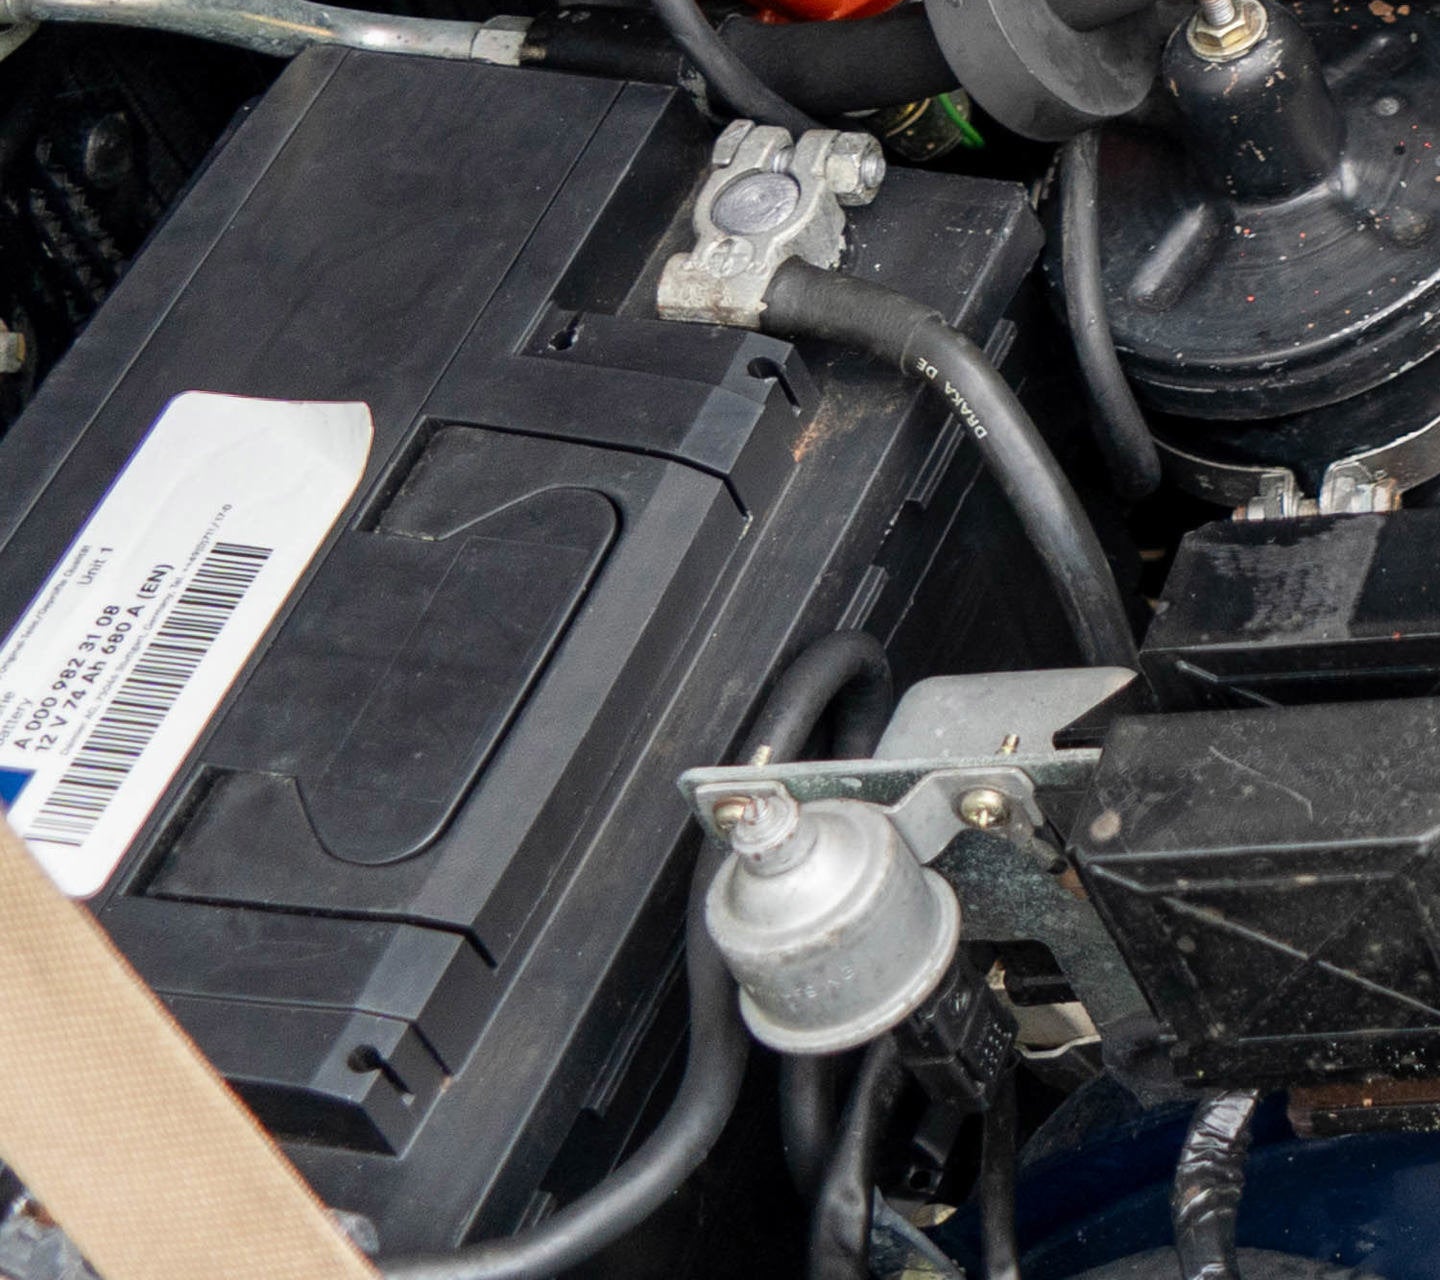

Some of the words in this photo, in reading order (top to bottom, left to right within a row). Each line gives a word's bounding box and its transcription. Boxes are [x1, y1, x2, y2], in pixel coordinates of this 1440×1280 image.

[940, 378, 989, 441] DRAKA
[78, 560, 105, 584] Unit
[14, 739, 31, 749] A
[25, 697, 57, 730] 000
[52, 658, 85, 690] 982
[79, 635, 101, 651] 31
[96, 606, 119, 626] 08
[36, 735, 57, 750] 12
[50, 716, 67, 727] V
[63, 690, 86, 708] 74
[82, 662, 106, 683] Ah
[101, 623, 131, 654] 680
[127, 606, 144, 617] A
[137, 565, 174, 599] (EN)
